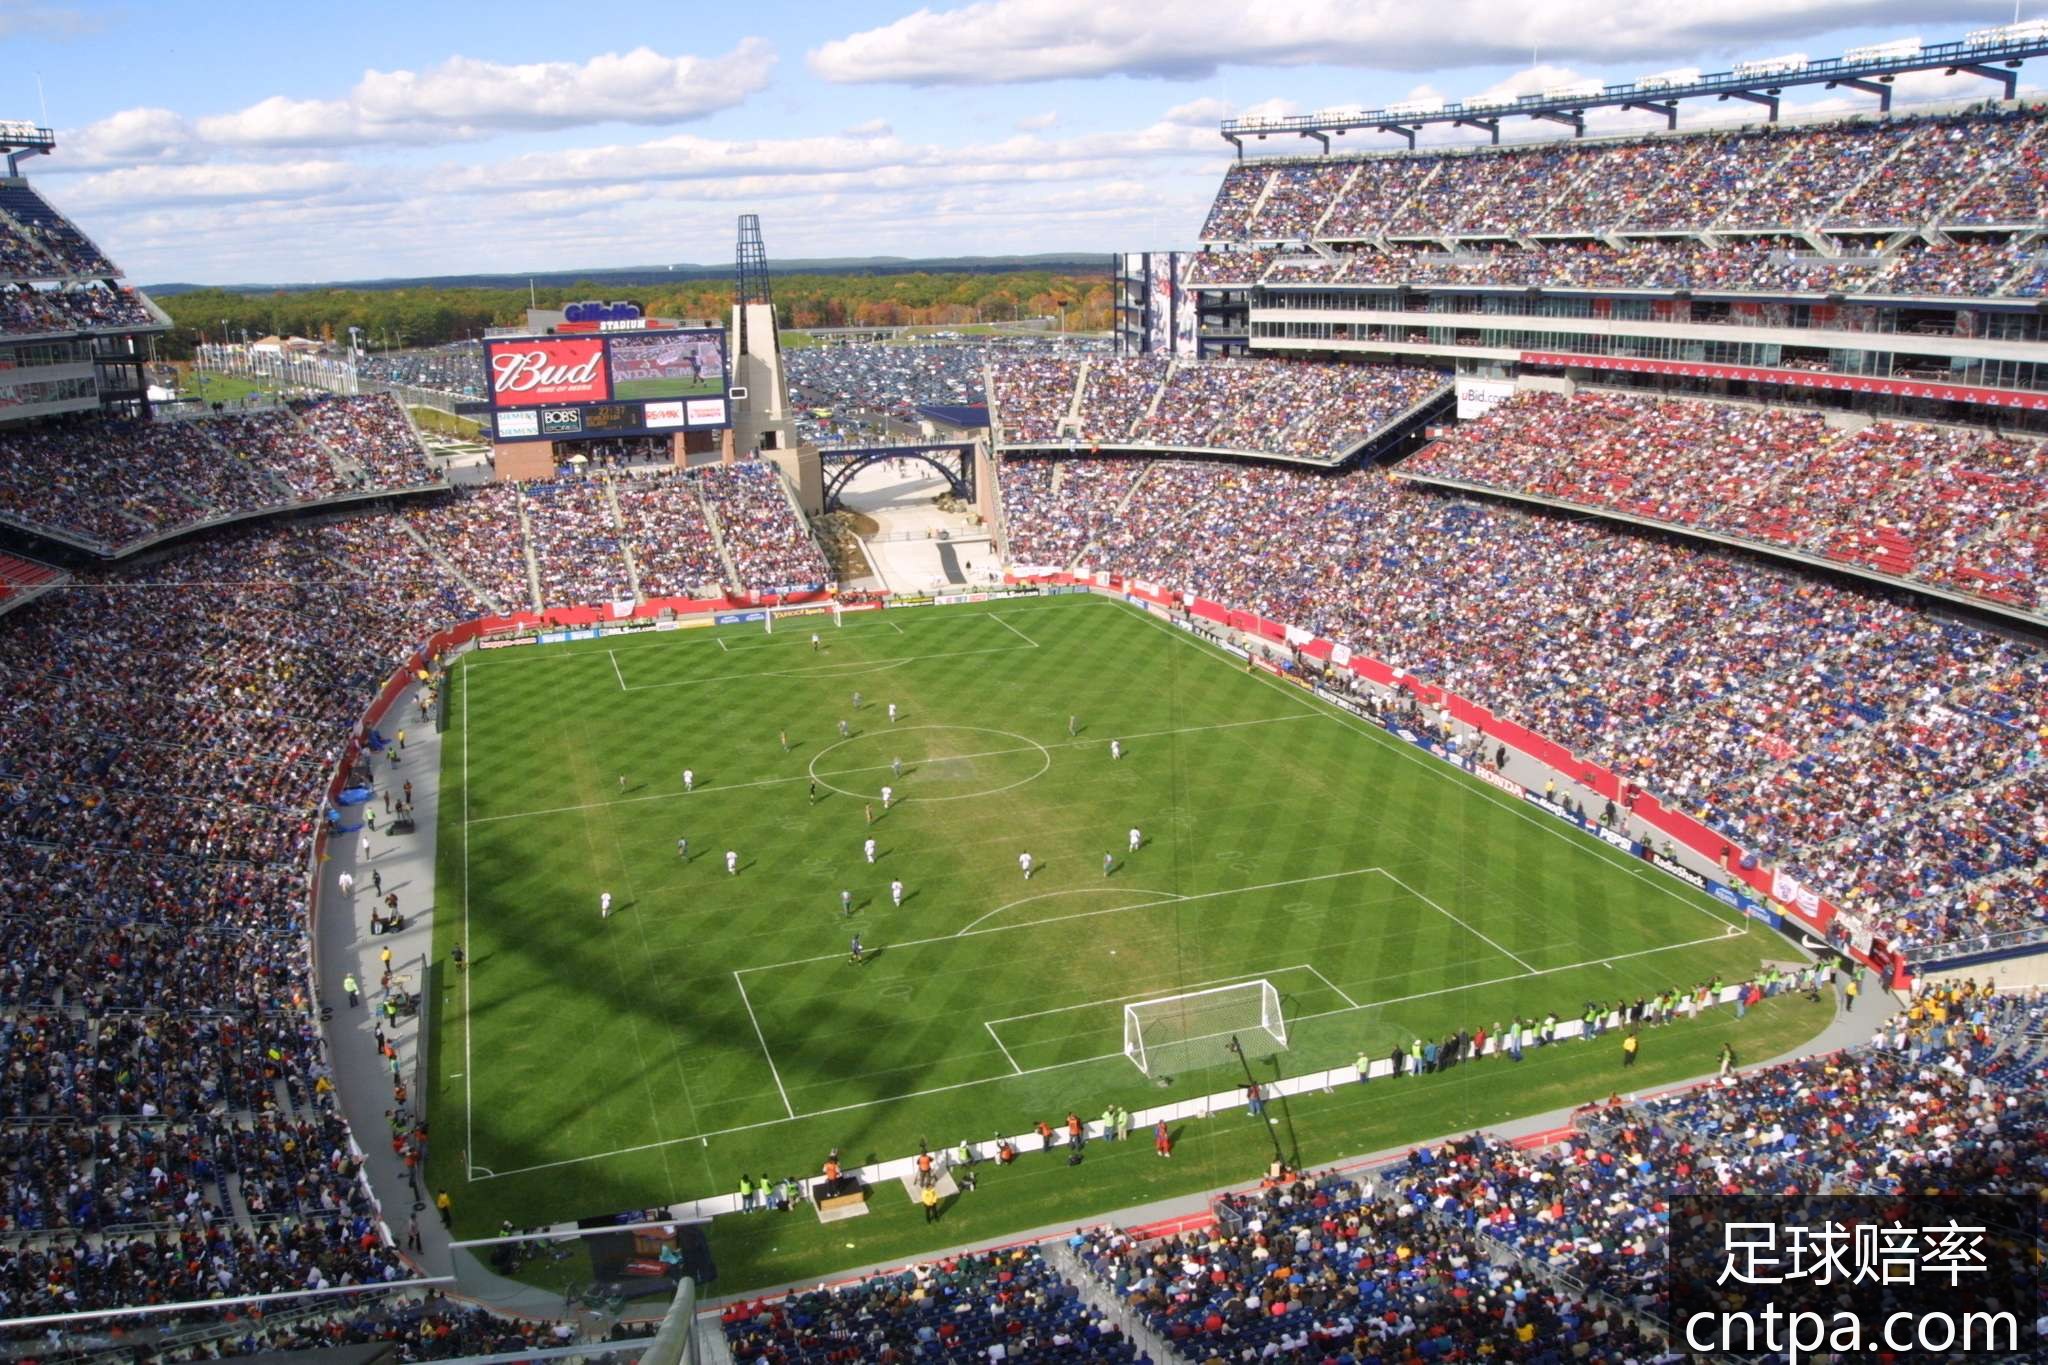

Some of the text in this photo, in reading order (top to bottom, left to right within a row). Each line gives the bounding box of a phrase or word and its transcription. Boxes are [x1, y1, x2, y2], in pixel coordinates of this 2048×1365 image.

[563, 302, 640, 323] Gillette
[600, 320, 646, 331] STADIUM
[492, 351, 602, 392] Bud
[544, 410, 578, 424] BOB'S
[1475, 765, 1525, 798] HONDA
[1600, 827, 1632, 851] PEPSI
